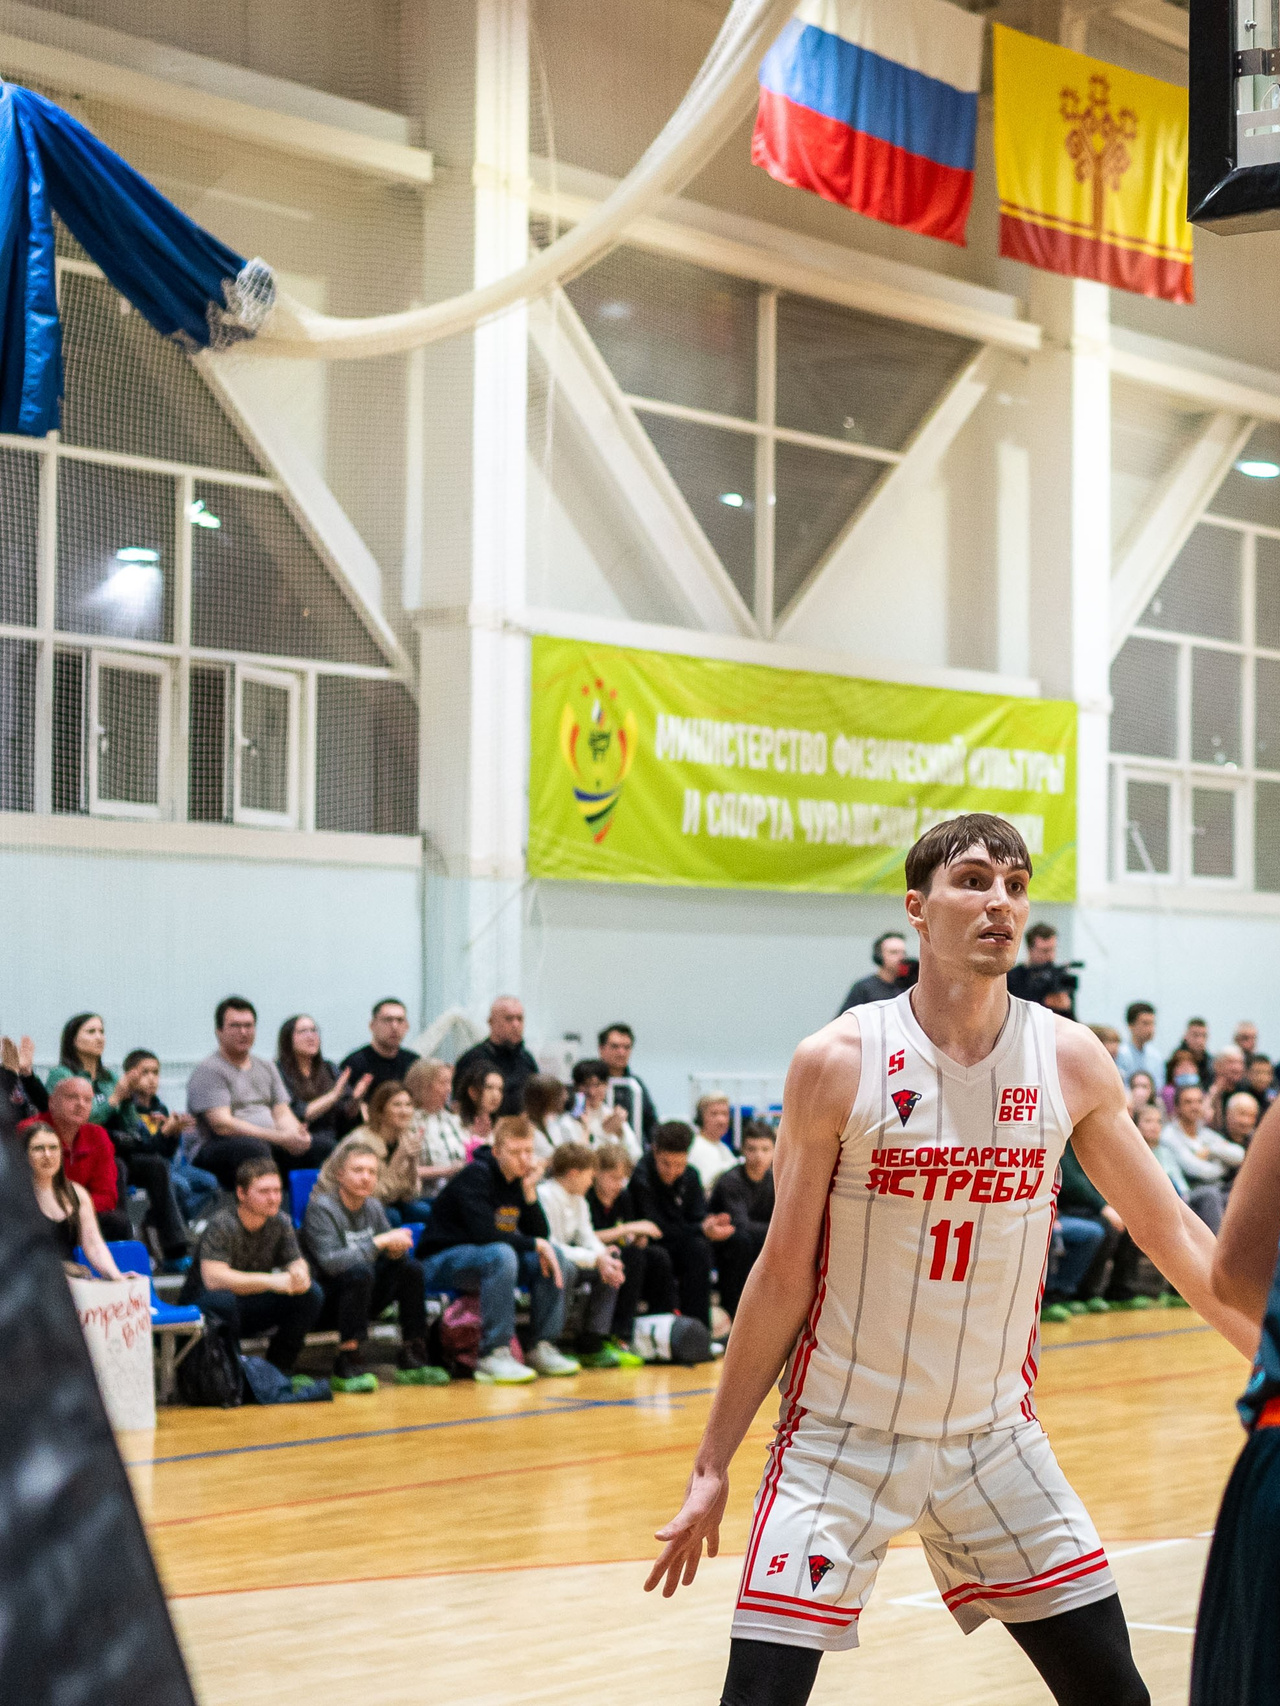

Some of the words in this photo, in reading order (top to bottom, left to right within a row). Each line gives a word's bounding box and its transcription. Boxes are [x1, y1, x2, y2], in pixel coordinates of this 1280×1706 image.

[655, 712, 828, 775] МИНИСТЕРСТВО
[832, 732, 965, 785] ФИЗИЧЕСКОЙ
[968, 747, 1065, 793] КУЛЬТУРЫ
[682, 788, 700, 835] И
[706, 790, 794, 841] СПОРТА
[798, 797, 916, 847] ЧУВАШСКОЙ
[1001, 1087, 1037, 1104] FON
[998, 1105, 1036, 1122] BET
[871, 1147, 1047, 1168] ЧЕБОКСАРСКИЕ
[865, 1168, 1044, 1203] ЯСТРЕБЫ
[929, 1219, 974, 1281] 11
